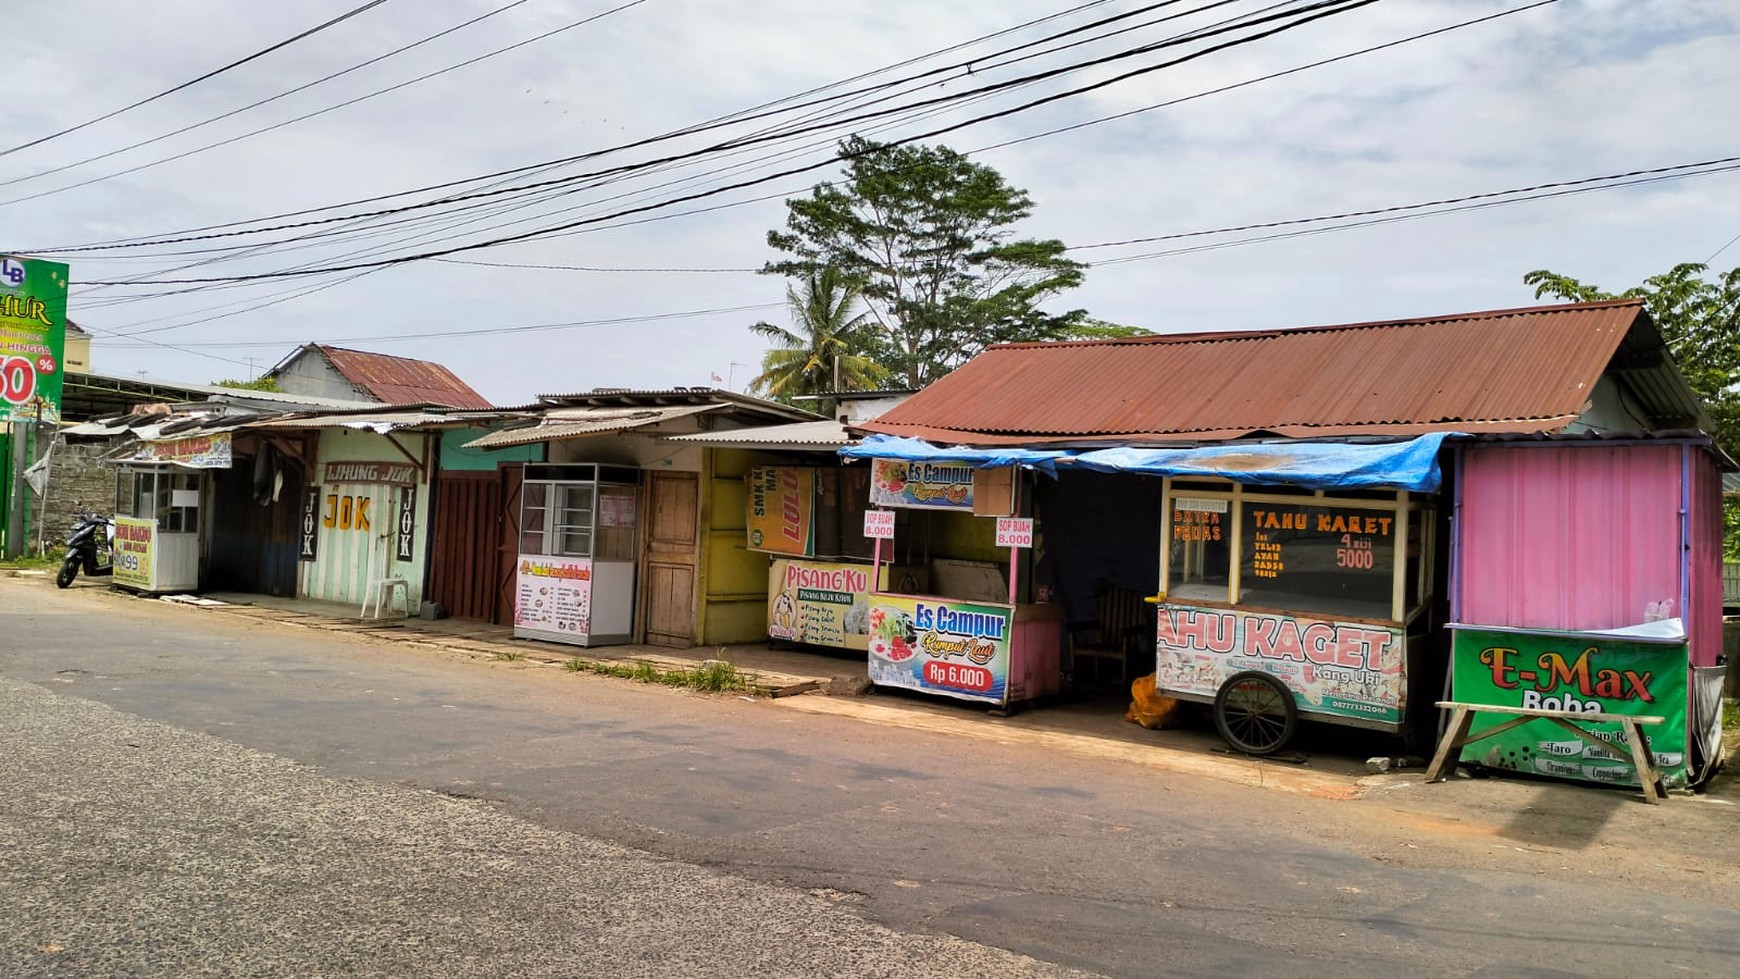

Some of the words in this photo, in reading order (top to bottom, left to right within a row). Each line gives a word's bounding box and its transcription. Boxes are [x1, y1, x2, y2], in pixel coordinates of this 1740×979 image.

[381, 466, 414, 482] JOK
[302, 493, 317, 555] JOK
[323, 494, 371, 531] JOK
[400, 489, 415, 557] JOK
[1253, 510, 1307, 529] TAHU
[1317, 514, 1392, 535] KAGET
[865, 526, 892, 536] 8.000
[998, 534, 1030, 545] 8.000
[1174, 525, 1221, 541] PEDAS
[1341, 534, 1351, 548] 4
[1336, 549, 1373, 570] 5000
[915, 604, 933, 629] Es
[937, 606, 1004, 639] Campur
[922, 632, 966, 657] Rumput
[967, 638, 995, 664] Laut
[1244, 616, 1392, 671] KAGET
[930, 664, 946, 682] Rp
[948, 667, 985, 687] 6.000
[1313, 664, 1350, 684] Kang
[1481, 646, 1657, 702] E-Max
[1547, 743, 1571, 755] Taro
